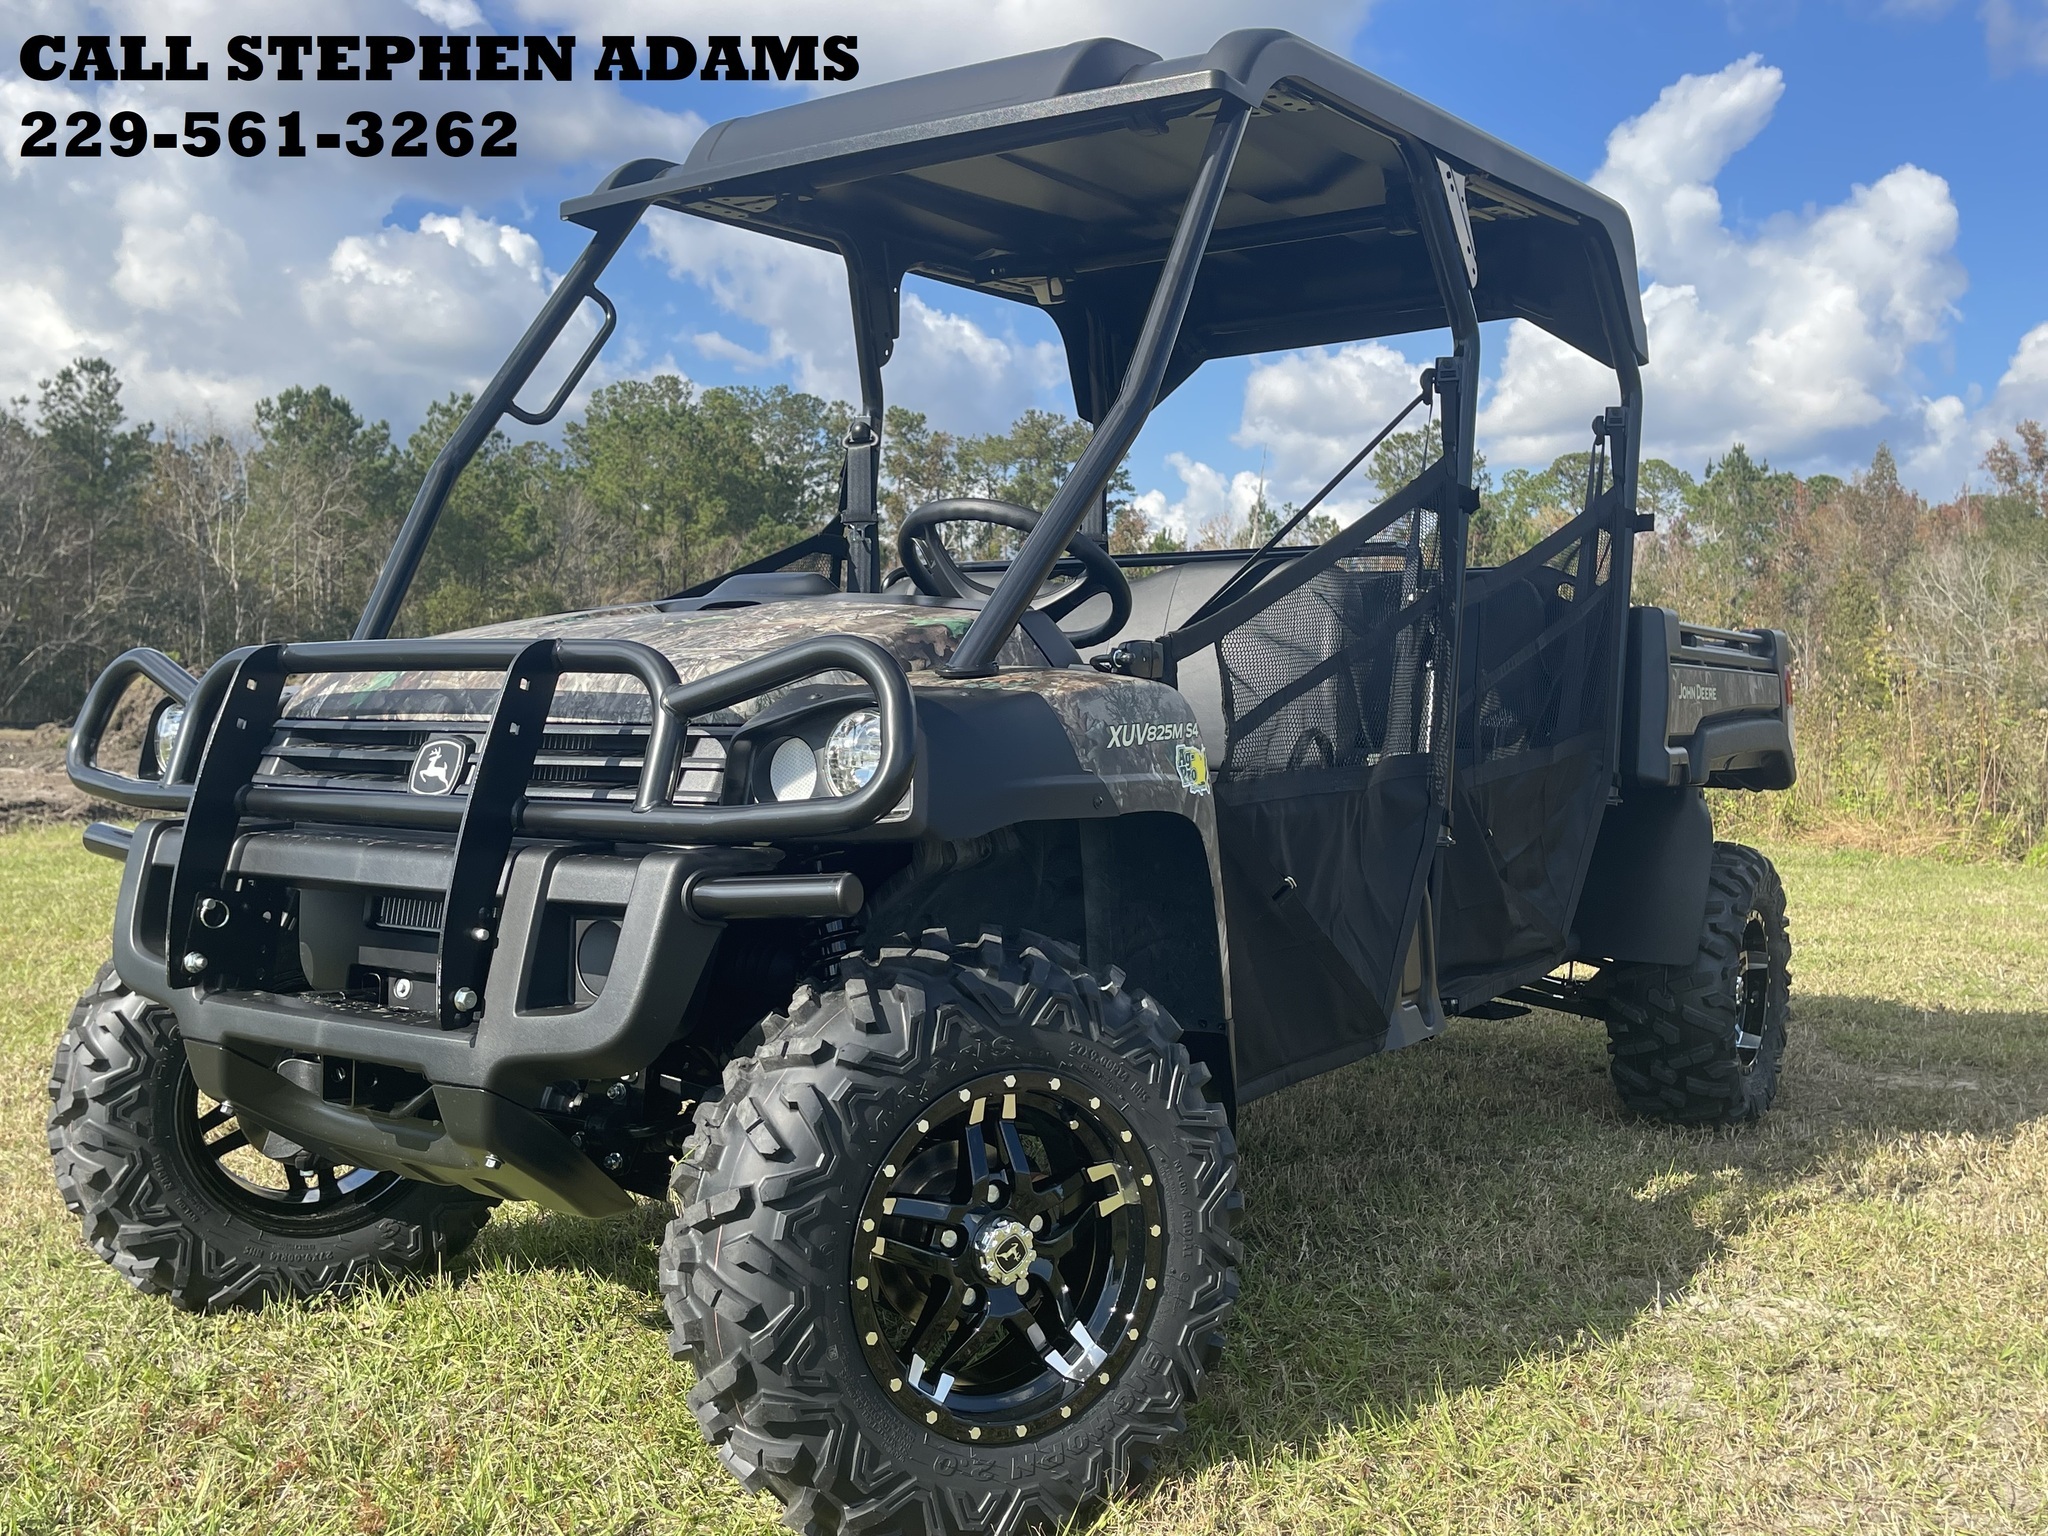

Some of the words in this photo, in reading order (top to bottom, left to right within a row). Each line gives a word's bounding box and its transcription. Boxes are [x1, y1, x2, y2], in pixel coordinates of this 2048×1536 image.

[1678, 682, 1695, 700] JOHN
[1696, 683, 1718, 701] DEERE
[1107, 722, 1183, 749] XUV825M
[1185, 722, 1199, 740] S4
[1180, 765, 1198, 784] Pro
